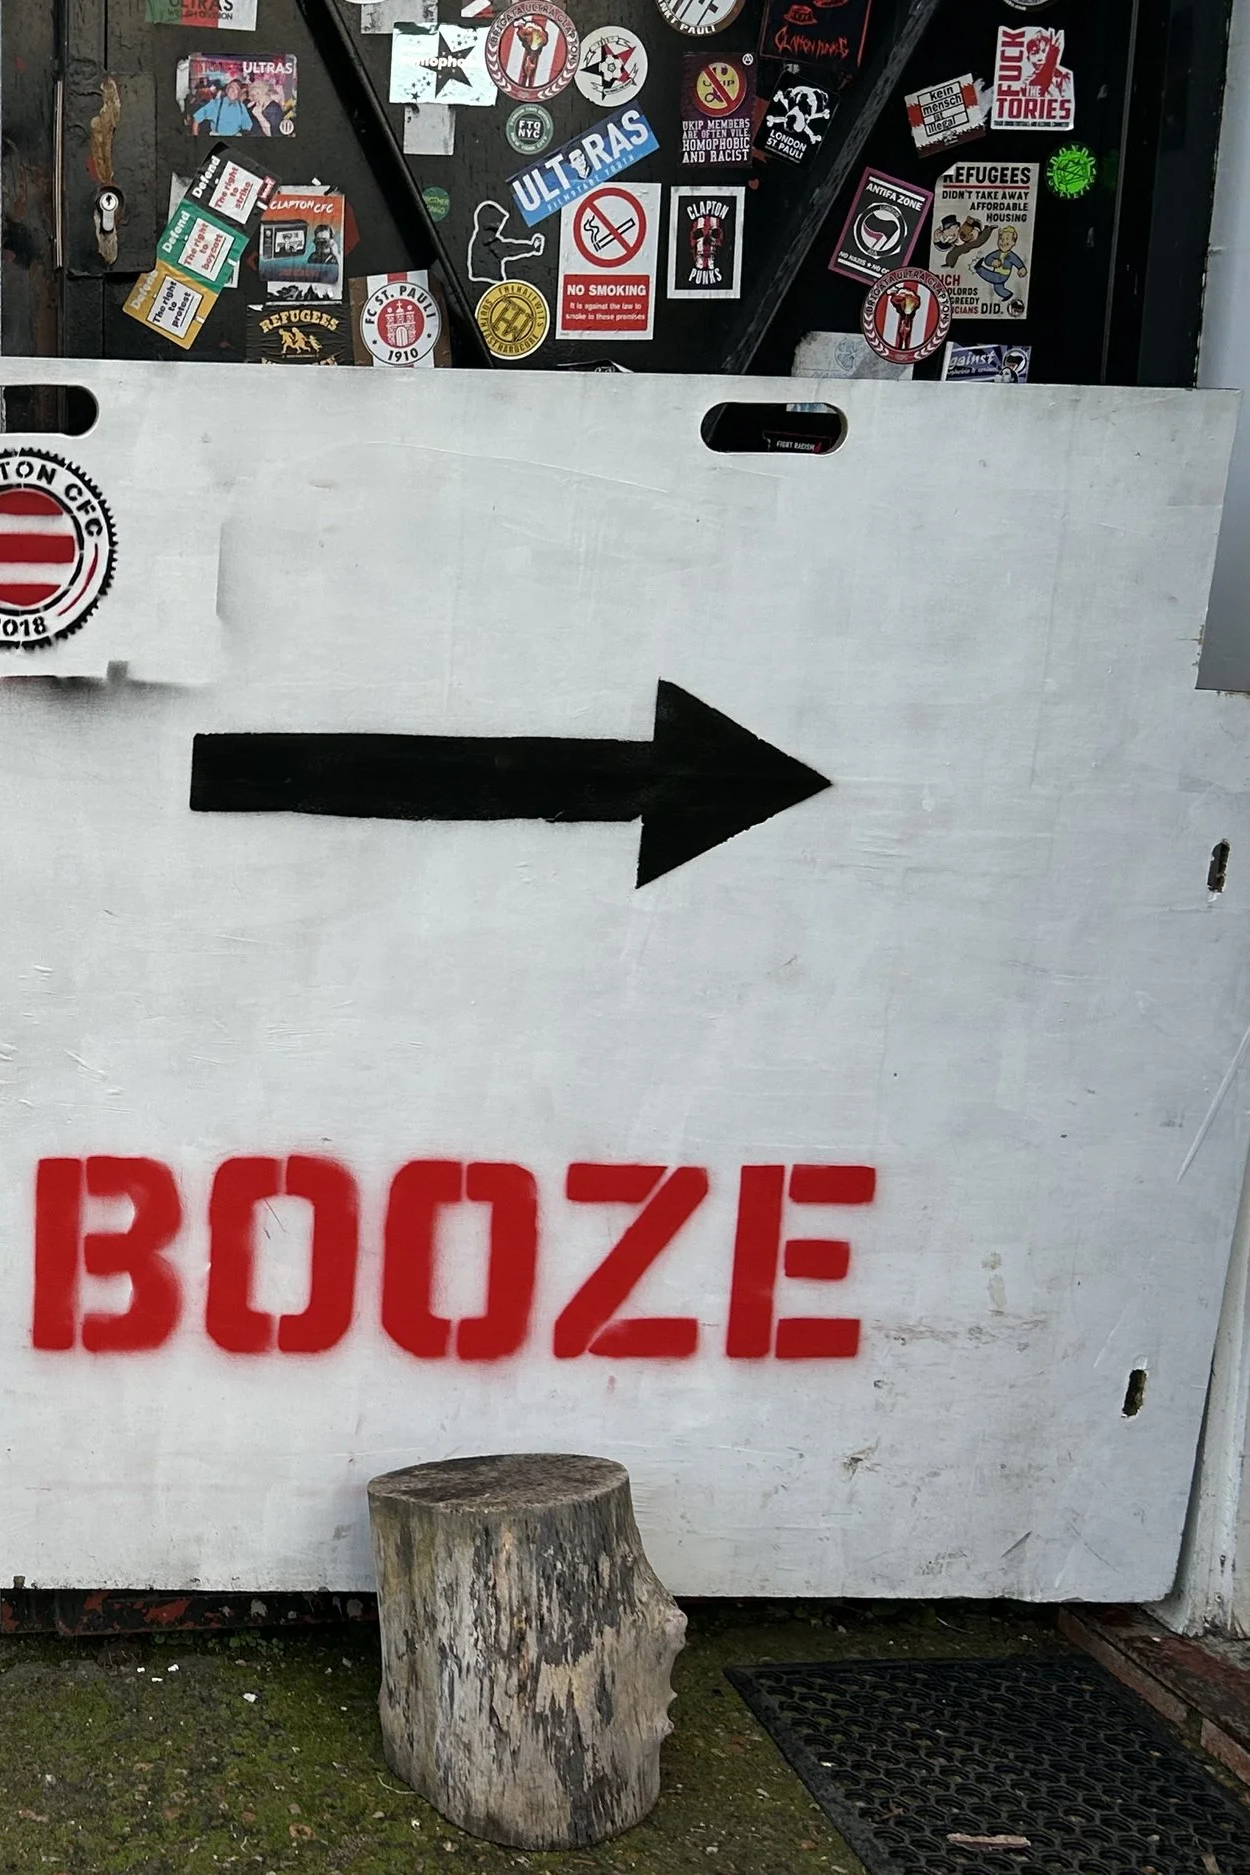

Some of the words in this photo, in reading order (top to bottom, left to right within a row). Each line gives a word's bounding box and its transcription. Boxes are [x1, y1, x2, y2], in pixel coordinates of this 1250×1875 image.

[491, 6, 522, 44] BRIGATA
[523, 3, 556, 17] ULTRA
[557, 14, 579, 61] CLAPTON
[679, 23, 716, 35] PAULI
[242, 62, 293, 75] ULTRAS
[997, 30, 1026, 97] FUCK
[1026, 85, 1042, 97] THE
[703, 79, 735, 87] UIP
[930, 86, 954, 101] kein
[922, 94, 962, 115] mensch
[996, 98, 1072, 120] TORIES
[682, 120, 704, 131] UKIP
[707, 118, 750, 130] MEMBERS
[927, 116, 956, 134] illegal
[518, 129, 541, 138] NYC
[682, 130, 698, 139] ARE
[701, 129, 727, 139] OFTEN
[769, 128, 808, 152] LONDON
[682, 137, 751, 151] HOMOPHOBIC
[777, 142, 804, 160] PAULI
[682, 151, 706, 164] AND
[709, 149, 749, 163] RACIST
[192, 154, 222, 199] Defend
[214, 190, 228, 209] The
[225, 166, 240, 191] right
[230, 187, 240, 197] to
[235, 181, 252, 209] strike
[942, 190, 973, 200] DIDN'T
[975, 190, 999, 200] TAKE
[1001, 191, 1030, 201] AWAY
[865, 183, 897, 202] ANTIFA
[897, 194, 924, 212] ZONE
[269, 199, 314, 211] CLAPTON
[313, 203, 334, 214] CFC
[686, 200, 730, 220] CLAPTON
[970, 202, 1029, 211] AFFORDABLE
[986, 213, 1028, 223] HOUSING
[162, 210, 191, 254] Defend
[184, 247, 198, 266] The
[195, 222, 209, 246] right
[199, 243, 209, 255] to
[201, 232, 224, 271] boycott
[838, 250, 849, 259] NO
[848, 254, 867, 267] NAZIS
[688, 267, 723, 285] PUNKS
[566, 284, 585, 296] NO
[588, 284, 647, 296] SMOKING
[896, 270, 926, 280] ULTRA
[927, 278, 950, 320] CLAPTON
[949, 287, 979, 296] DLORDS
[152, 305, 166, 324] The
[162, 280, 177, 306] right
[168, 301, 178, 312] to
[172, 291, 192, 328] protest
[365, 309, 377, 326] FC
[375, 288, 395, 307] ST.
[399, 285, 437, 318] PAULI
[569, 302, 575, 310] It
[576, 302, 583, 310] is
[584, 302, 608, 311] against
[609, 302, 621, 310] the
[621, 302, 634, 310] law
[634, 302, 642, 310] to
[981, 302, 1004, 315] DID.
[259, 309, 339, 333] REFUGEES
[565, 312, 587, 320] smoke
[615, 313, 646, 322] premises
[387, 347, 419, 362] 1910
[776, 439, 793, 450] FIGHT
[63, 482, 104, 538] CFC
[32, 1154, 877, 1362] BOOZE
